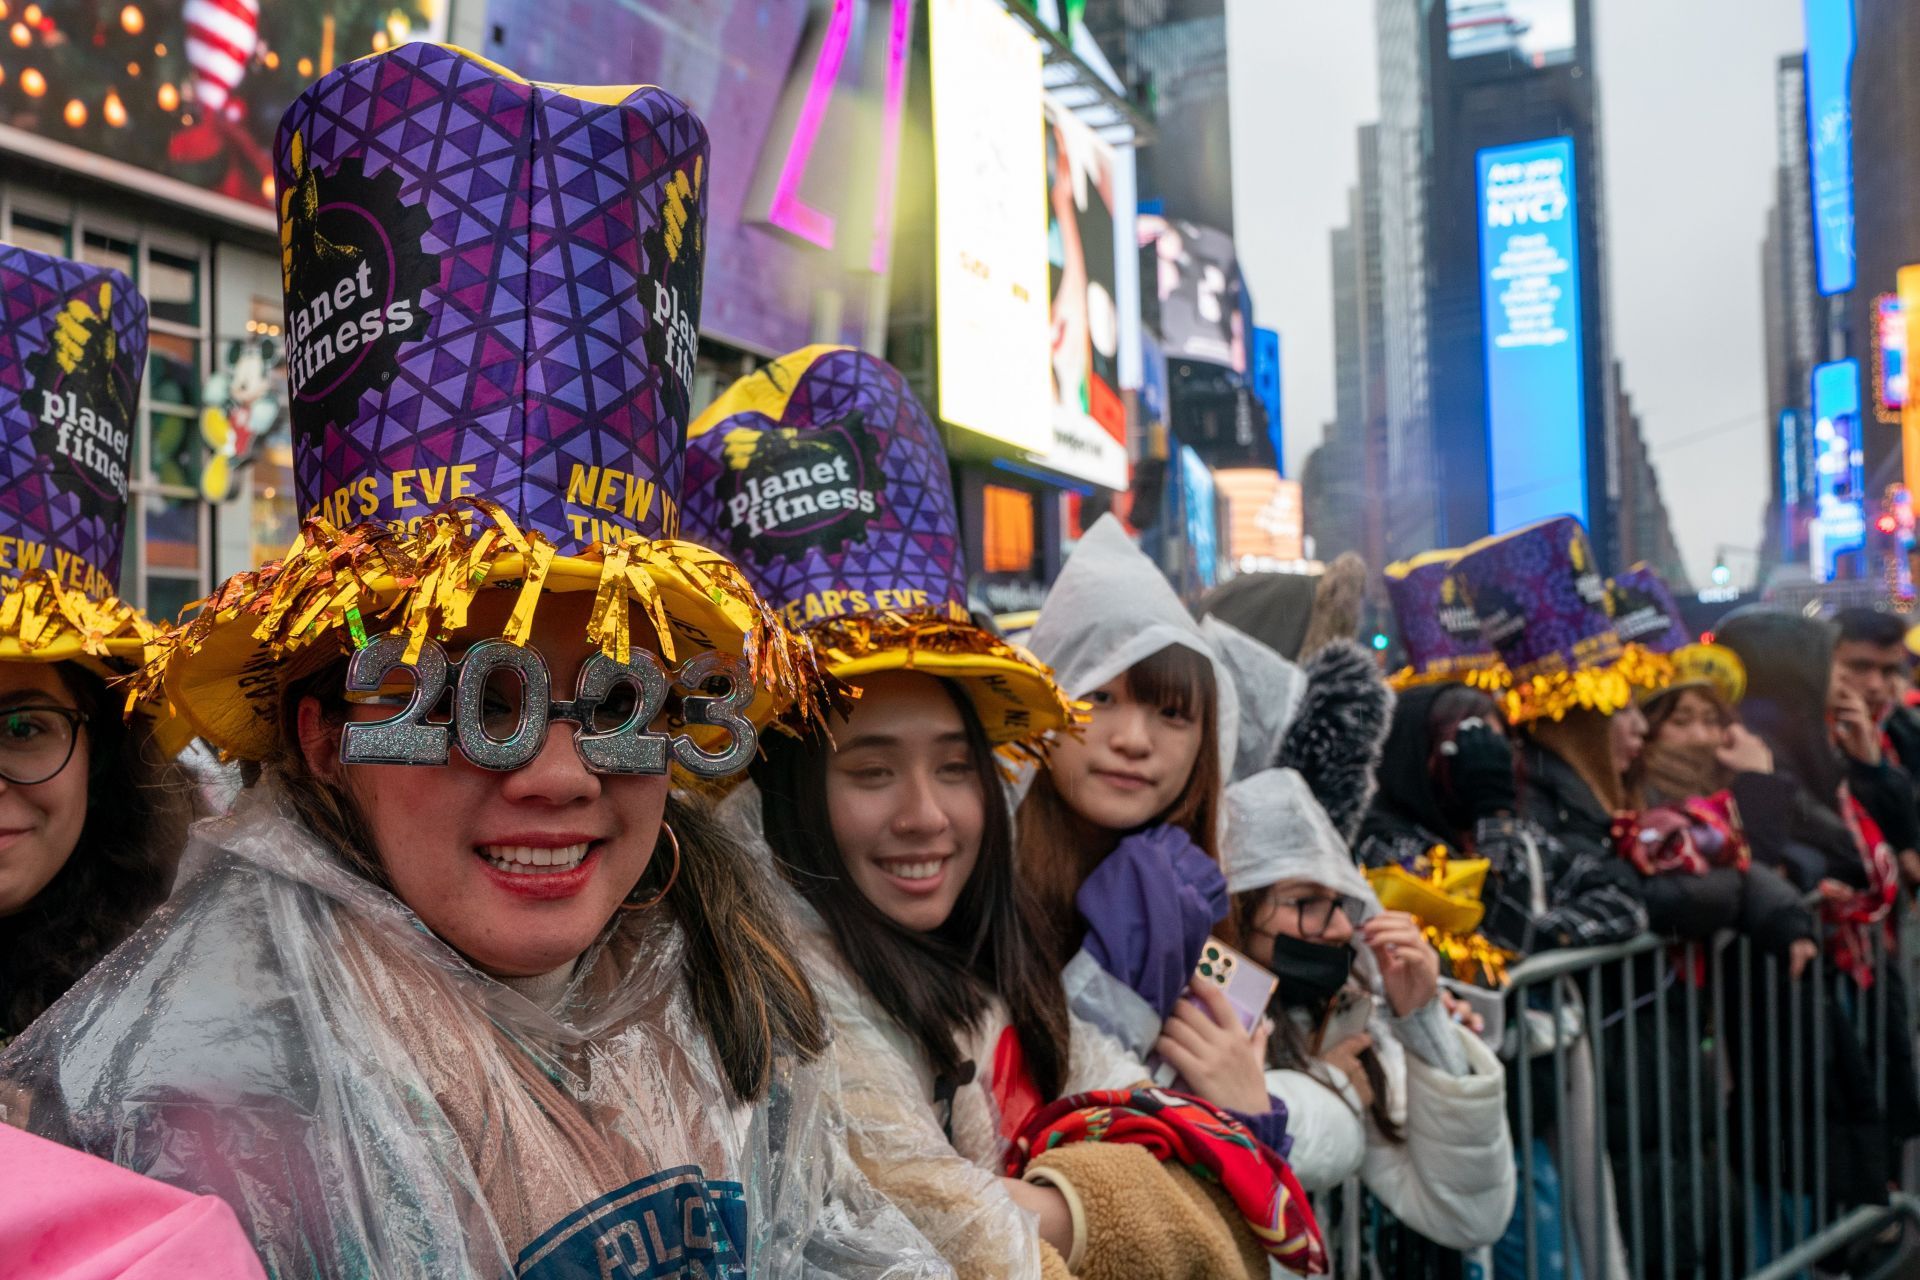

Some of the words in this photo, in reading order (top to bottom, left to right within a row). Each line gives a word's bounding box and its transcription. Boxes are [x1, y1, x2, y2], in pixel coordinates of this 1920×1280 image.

[291, 299, 414, 400] fitness
[392, 464, 477, 508] EVE
[567, 464, 655, 522] NEW
[728, 455, 850, 528] planet
[746, 488, 875, 538] fitness
[340, 632, 758, 776] 2023
